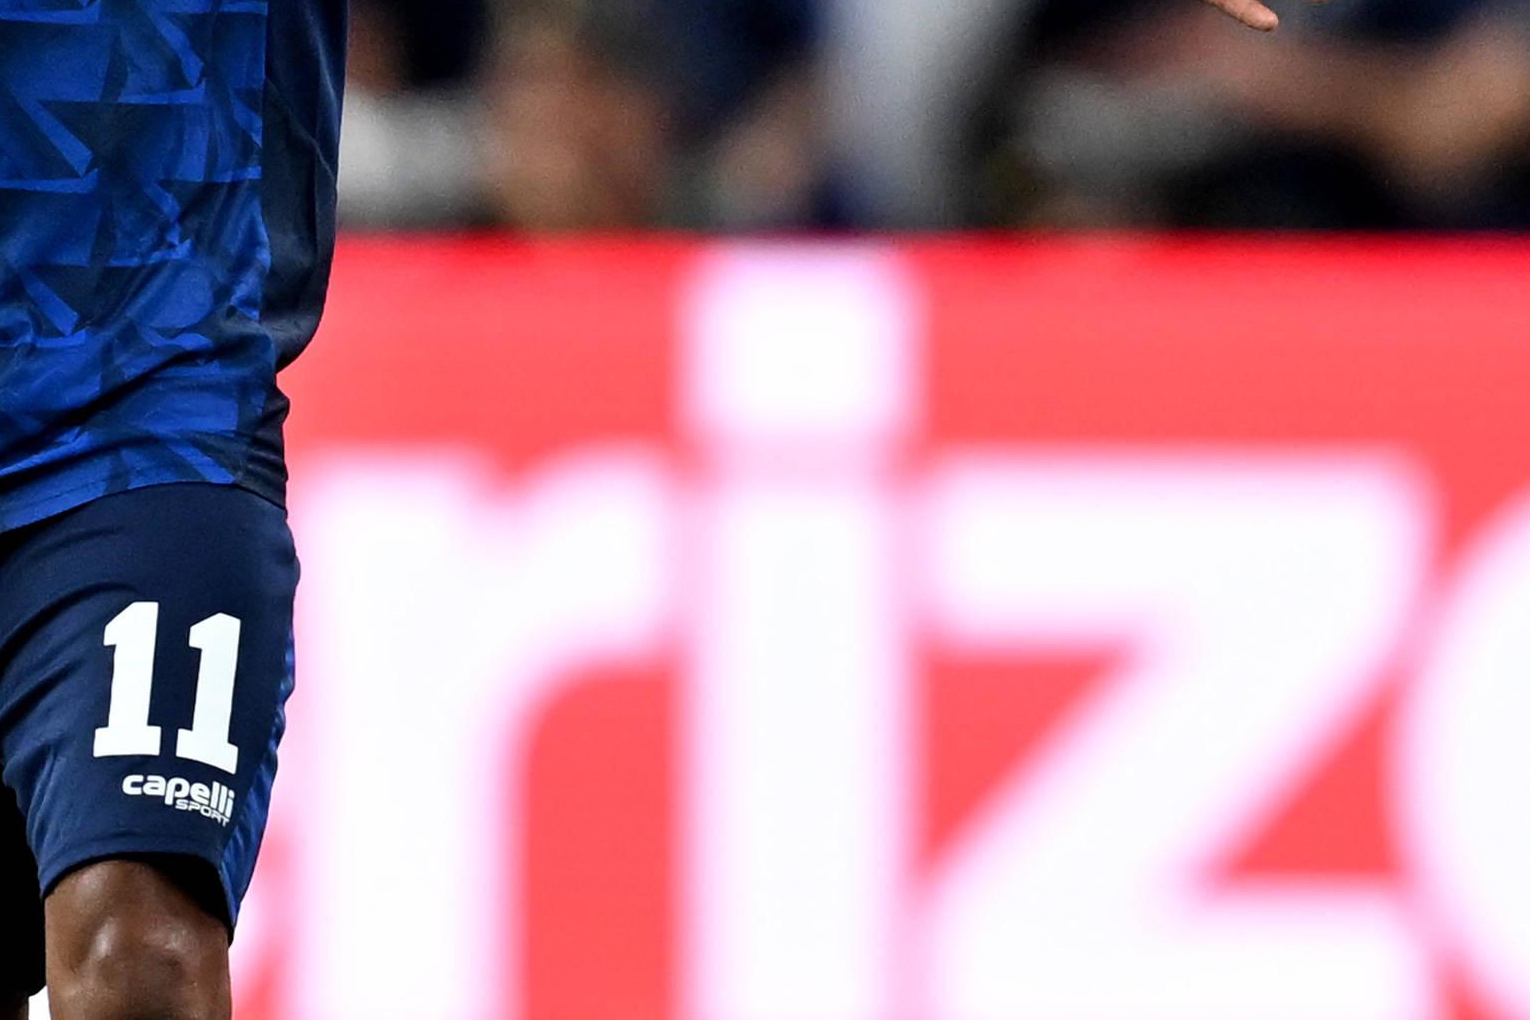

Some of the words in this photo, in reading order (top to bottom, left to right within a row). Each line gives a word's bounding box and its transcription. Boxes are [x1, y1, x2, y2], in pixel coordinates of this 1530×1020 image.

[93, 601, 242, 774] 11
[121, 773, 236, 819] capelli
[175, 798, 230, 828] SPORT
